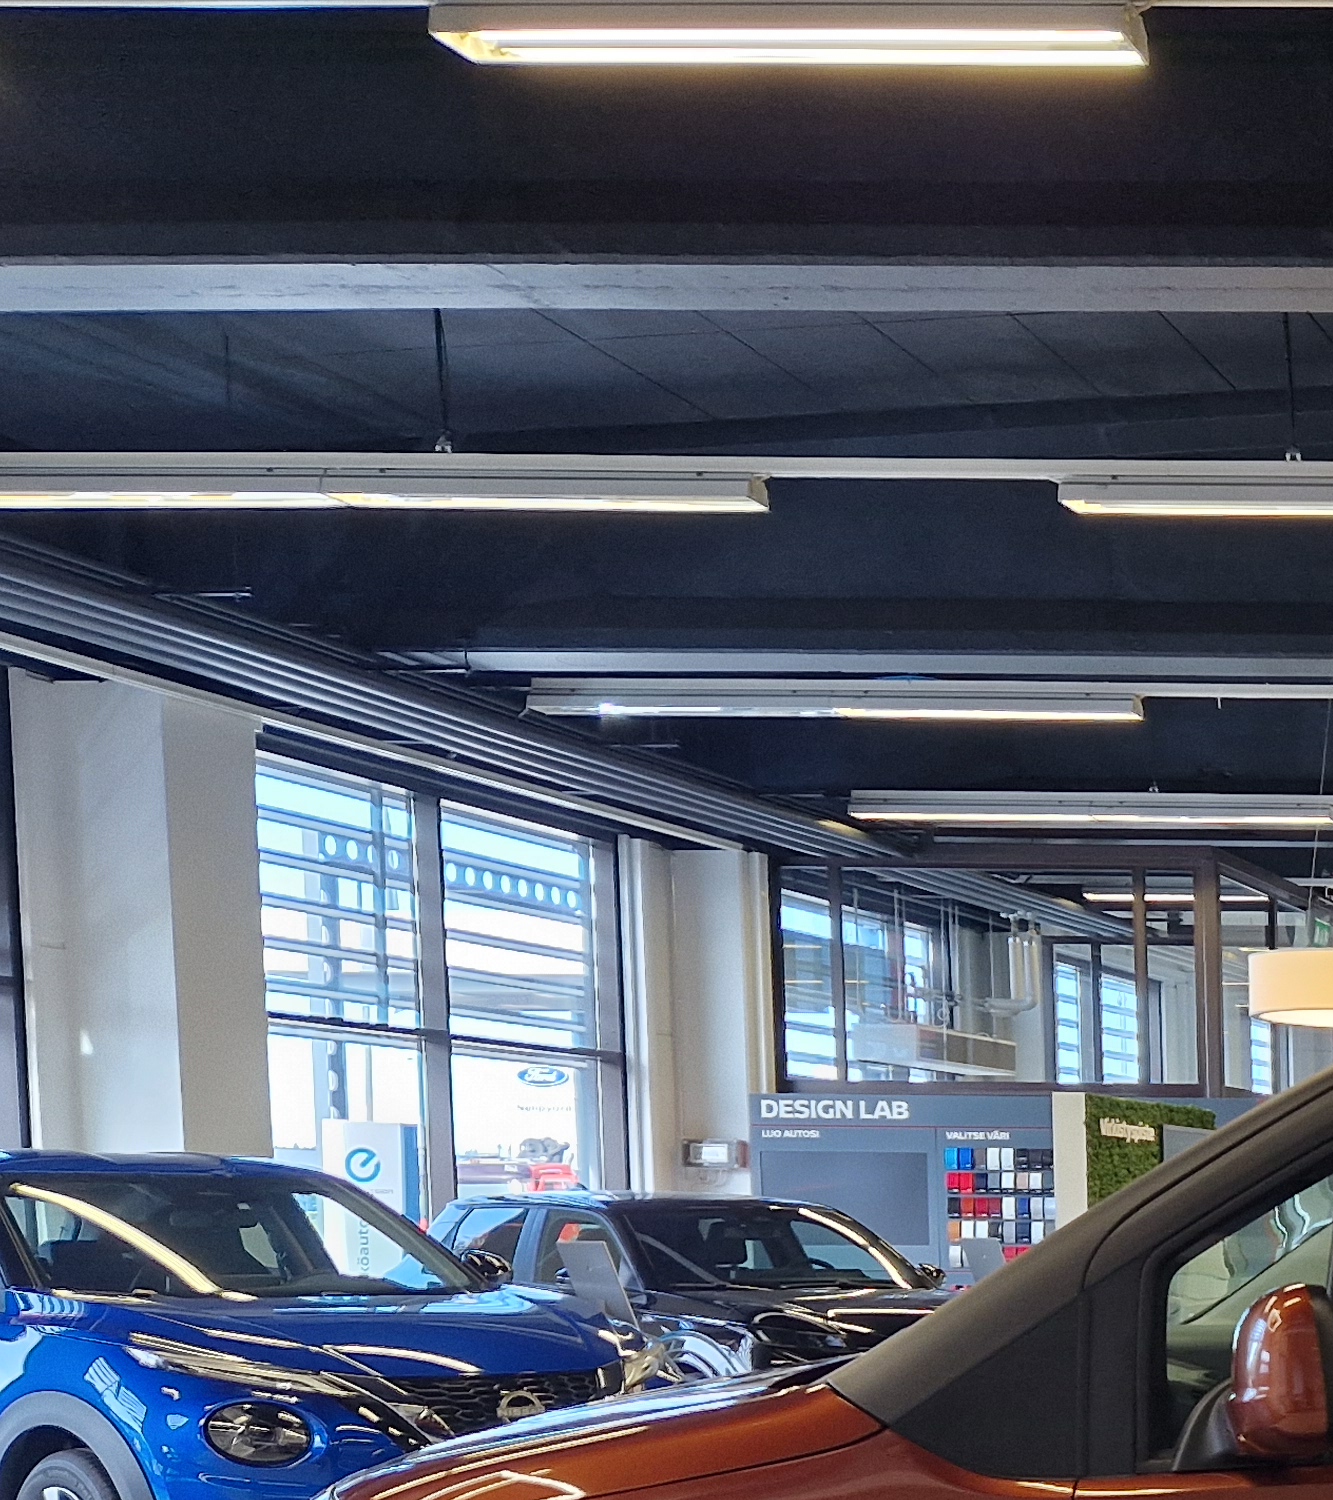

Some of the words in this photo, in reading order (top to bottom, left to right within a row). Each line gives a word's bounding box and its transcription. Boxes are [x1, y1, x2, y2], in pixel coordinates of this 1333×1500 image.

[760, 1099, 853, 1119] DESIGN
[859, 1100, 909, 1120] LAB
[761, 1129, 781, 1138] LUO
[782, 1130, 820, 1138] AUTOSI
[945, 1131, 985, 1140] VALITSE
[986, 1129, 1011, 1140] VÄRI
